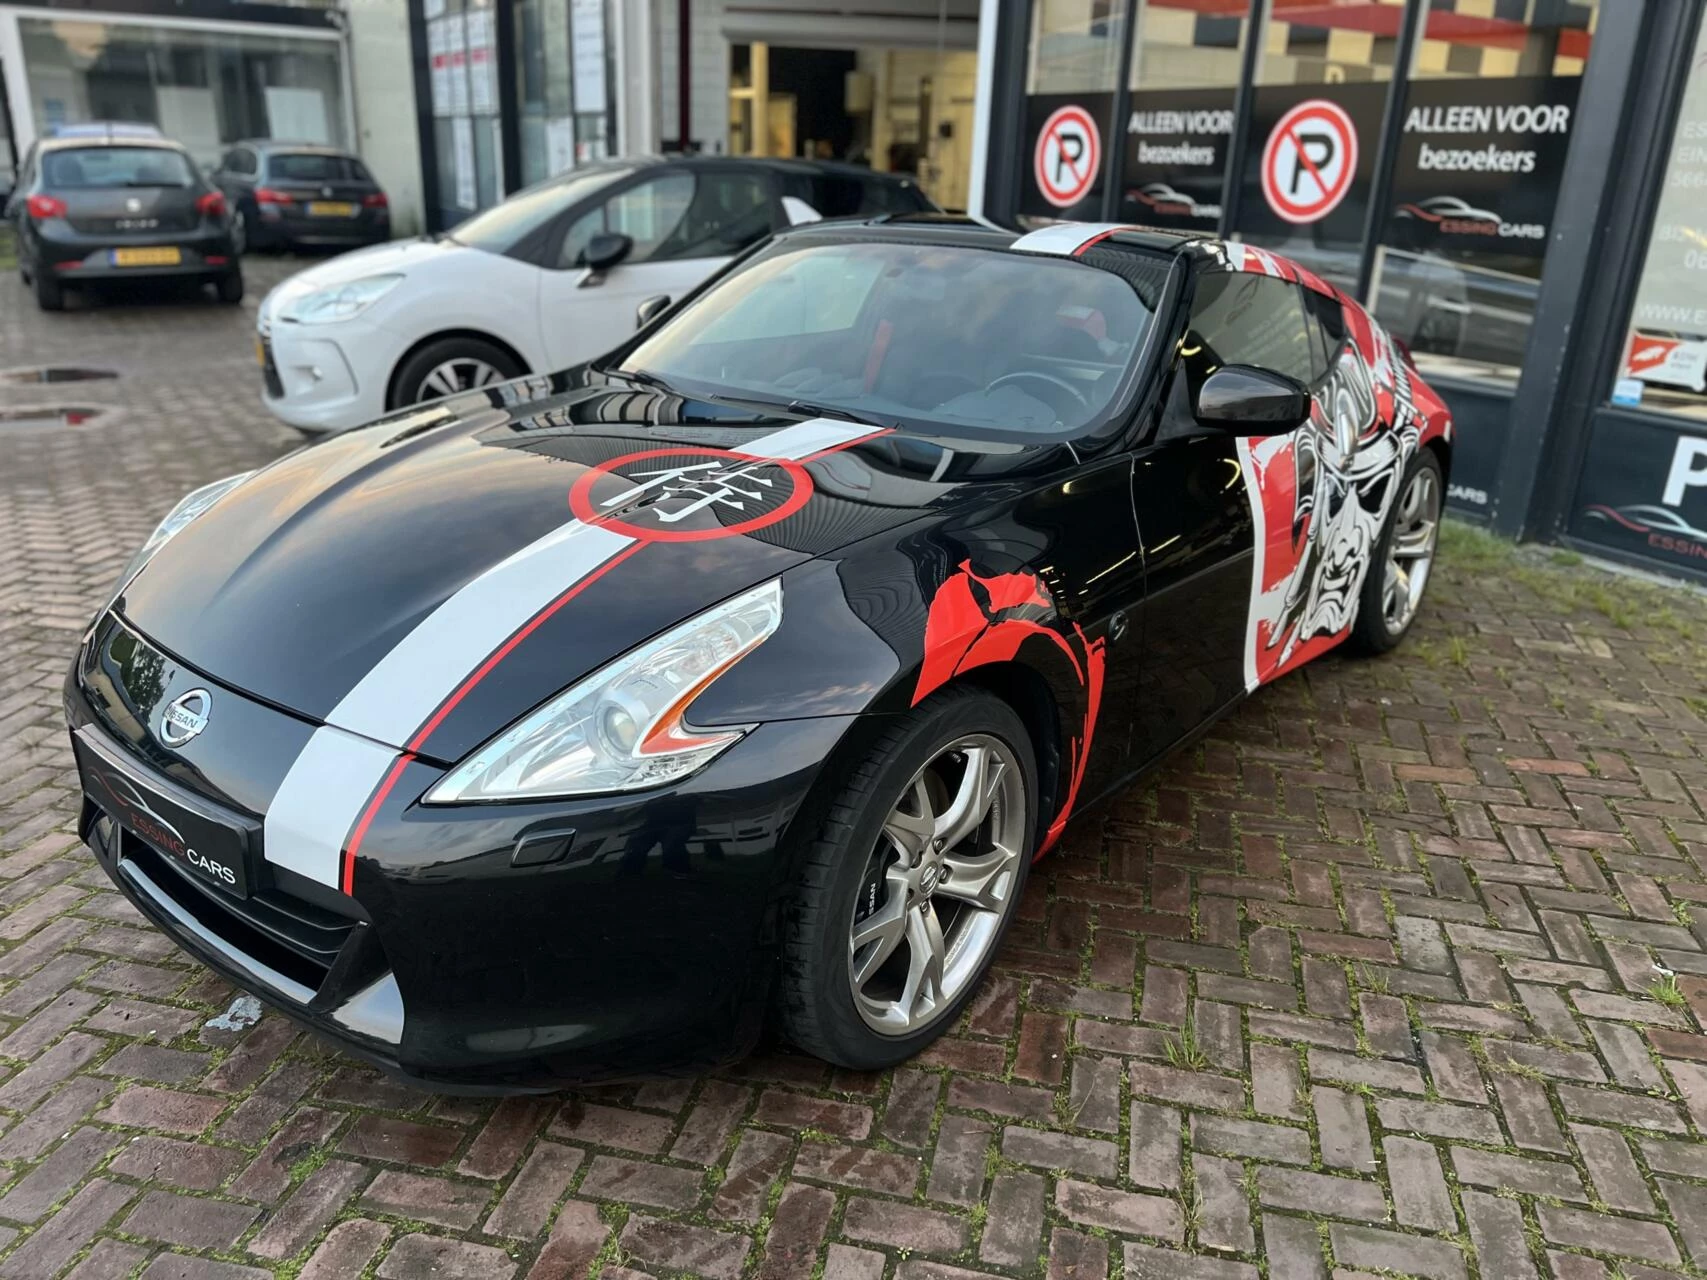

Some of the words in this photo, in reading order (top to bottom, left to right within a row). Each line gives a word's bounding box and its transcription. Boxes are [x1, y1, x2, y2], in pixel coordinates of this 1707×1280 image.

[1127, 109, 1185, 134] ALLEEN
[1183, 109, 1234, 134] VOOR
[1403, 105, 1493, 133] ALLEEN
[1496, 104, 1570, 133] VOOR
[1138, 139, 1215, 165] bezoekers
[1418, 142, 1536, 173] bezoekers
[1498, 222, 1546, 240] CARS
[167, 703, 199, 729] NISSAN
[130, 812, 185, 857] ESSING
[186, 848, 237, 885] CARS
